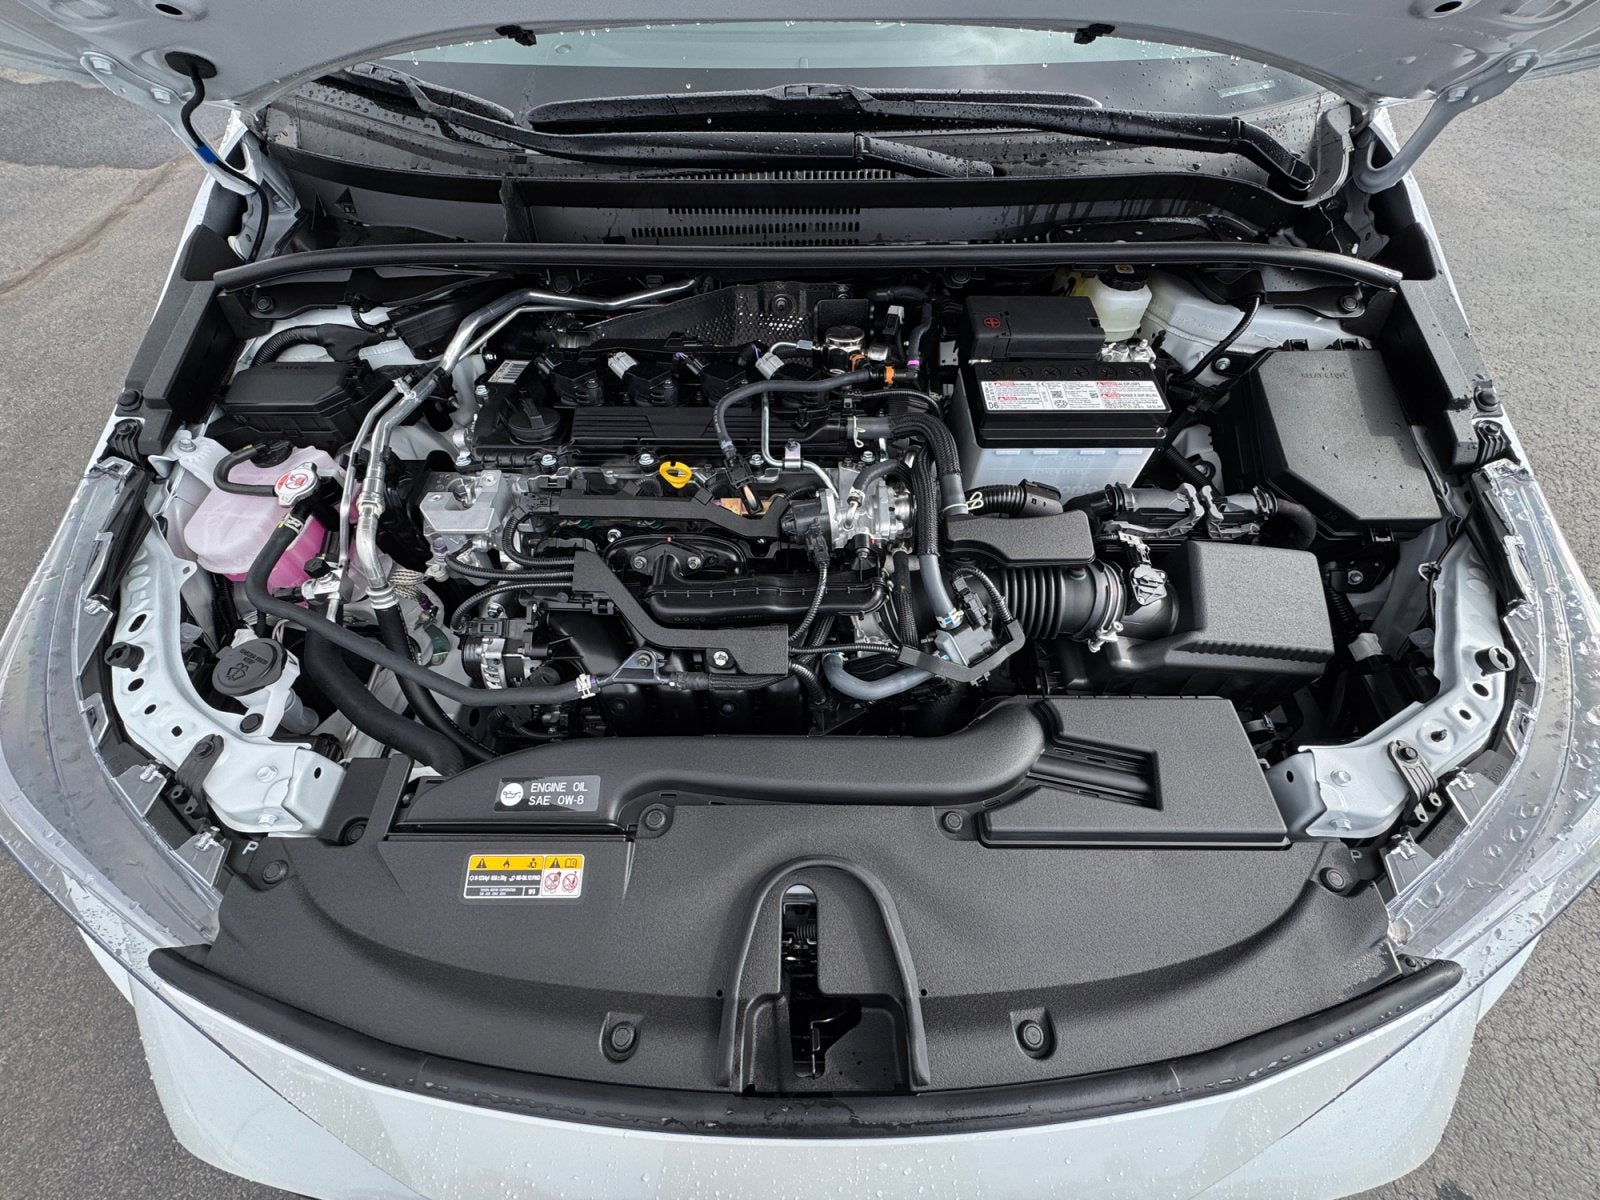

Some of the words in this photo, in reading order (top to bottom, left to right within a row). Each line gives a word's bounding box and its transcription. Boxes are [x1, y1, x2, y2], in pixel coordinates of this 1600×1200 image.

[530, 782, 567, 792] ENGINE
[573, 782, 588, 792] OIL
[528, 795, 551, 805] SAE
[557, 795, 585, 805] 0W-8
[242, 841, 259, 854] P
[1351, 850, 1362, 863] P
